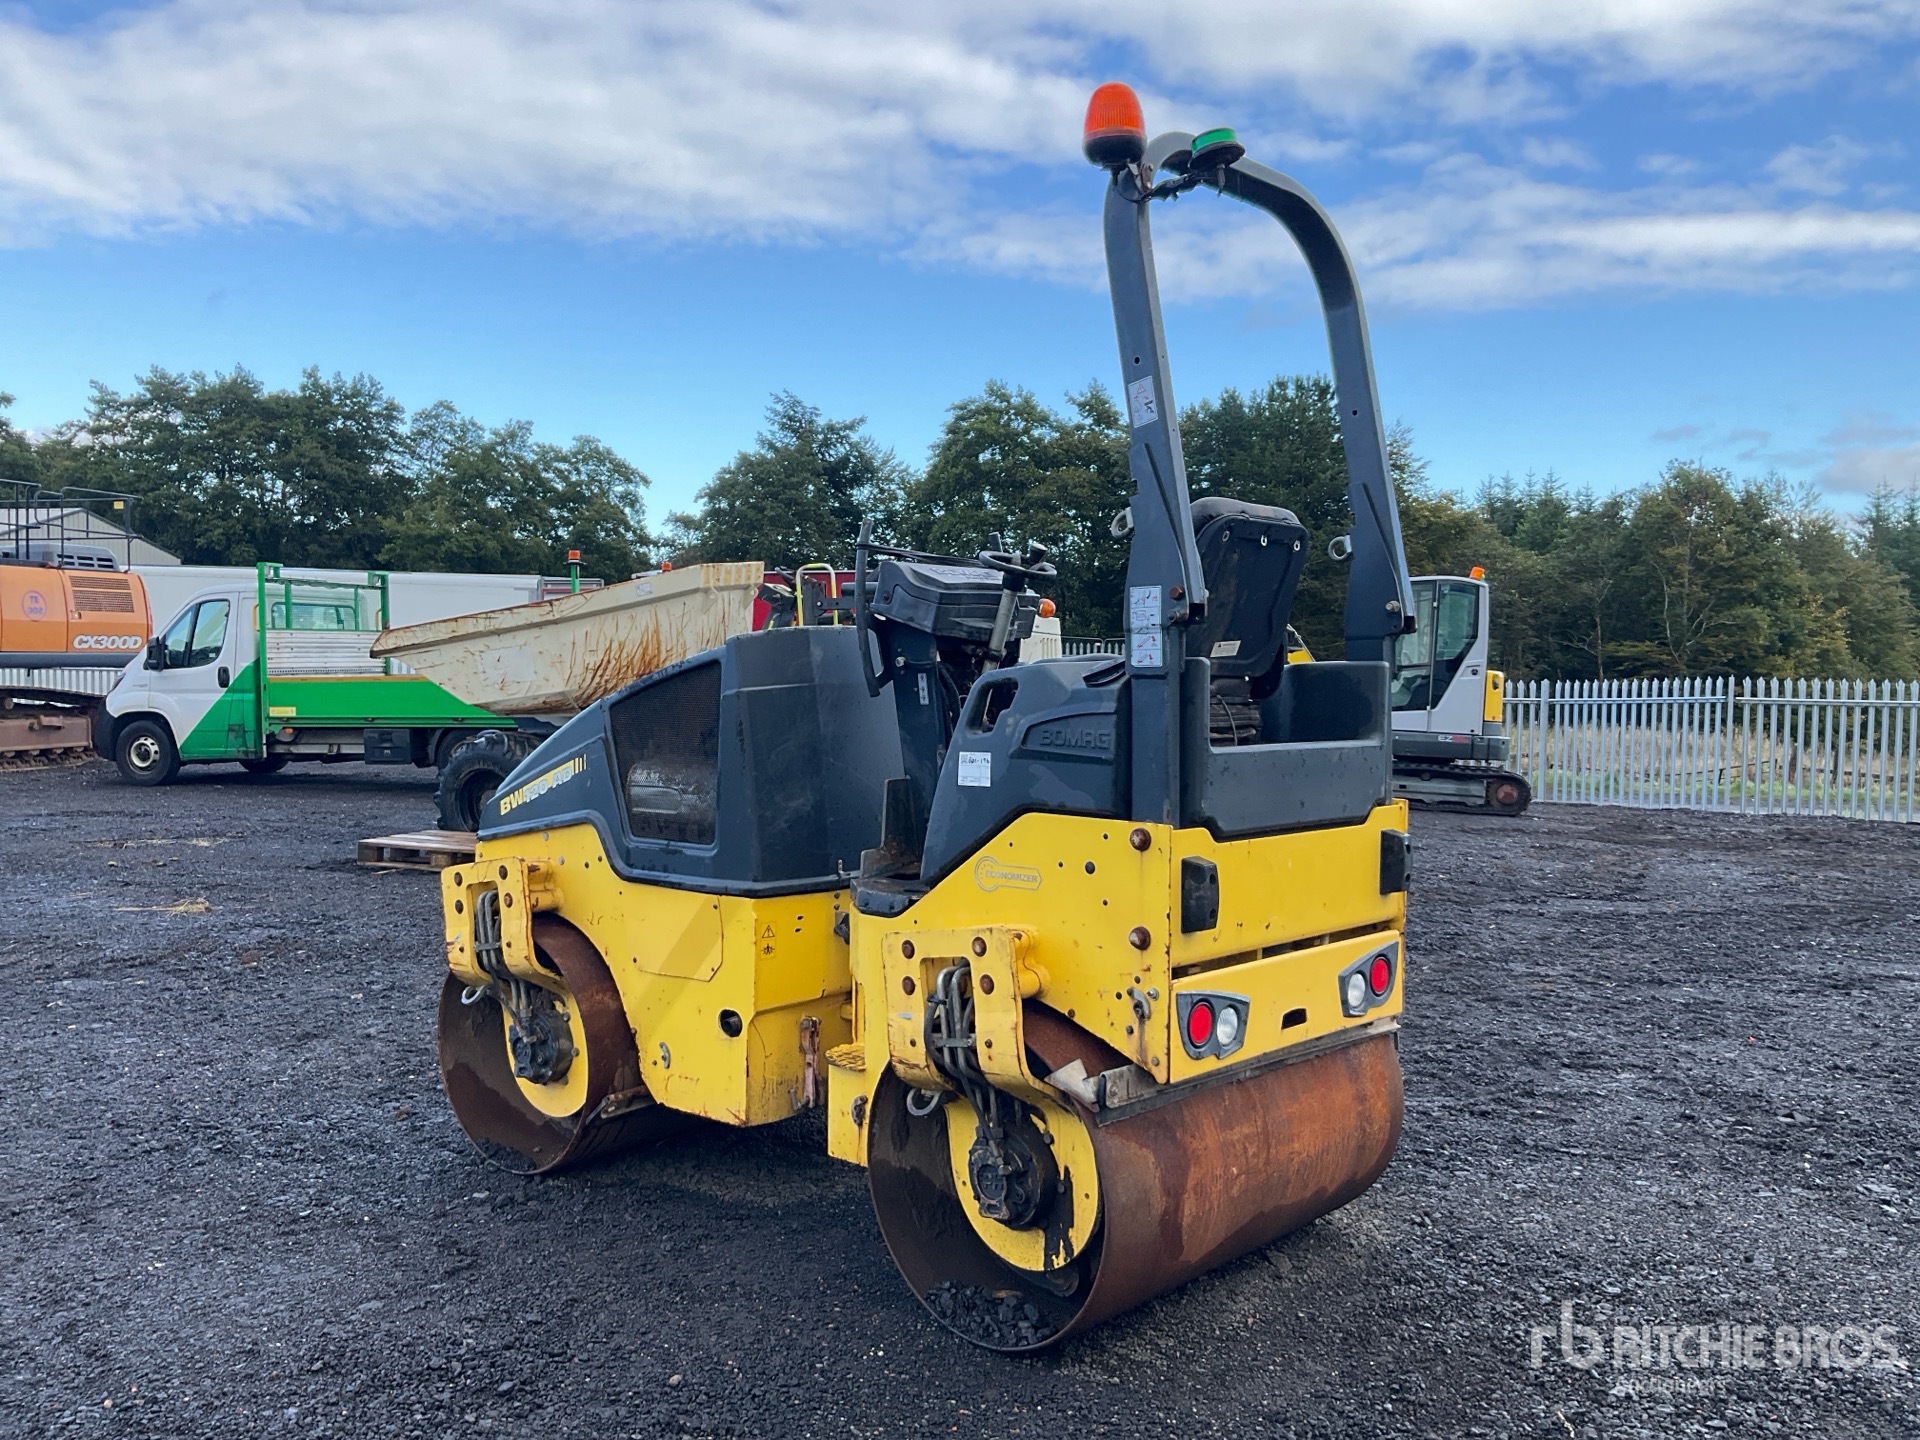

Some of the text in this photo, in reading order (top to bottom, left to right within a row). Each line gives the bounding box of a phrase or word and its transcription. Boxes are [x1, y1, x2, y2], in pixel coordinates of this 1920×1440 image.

[73, 634, 142, 649] CX300D
[1040, 729, 1111, 749] BOMAG
[985, 869, 1037, 882] ECONOMIZER
